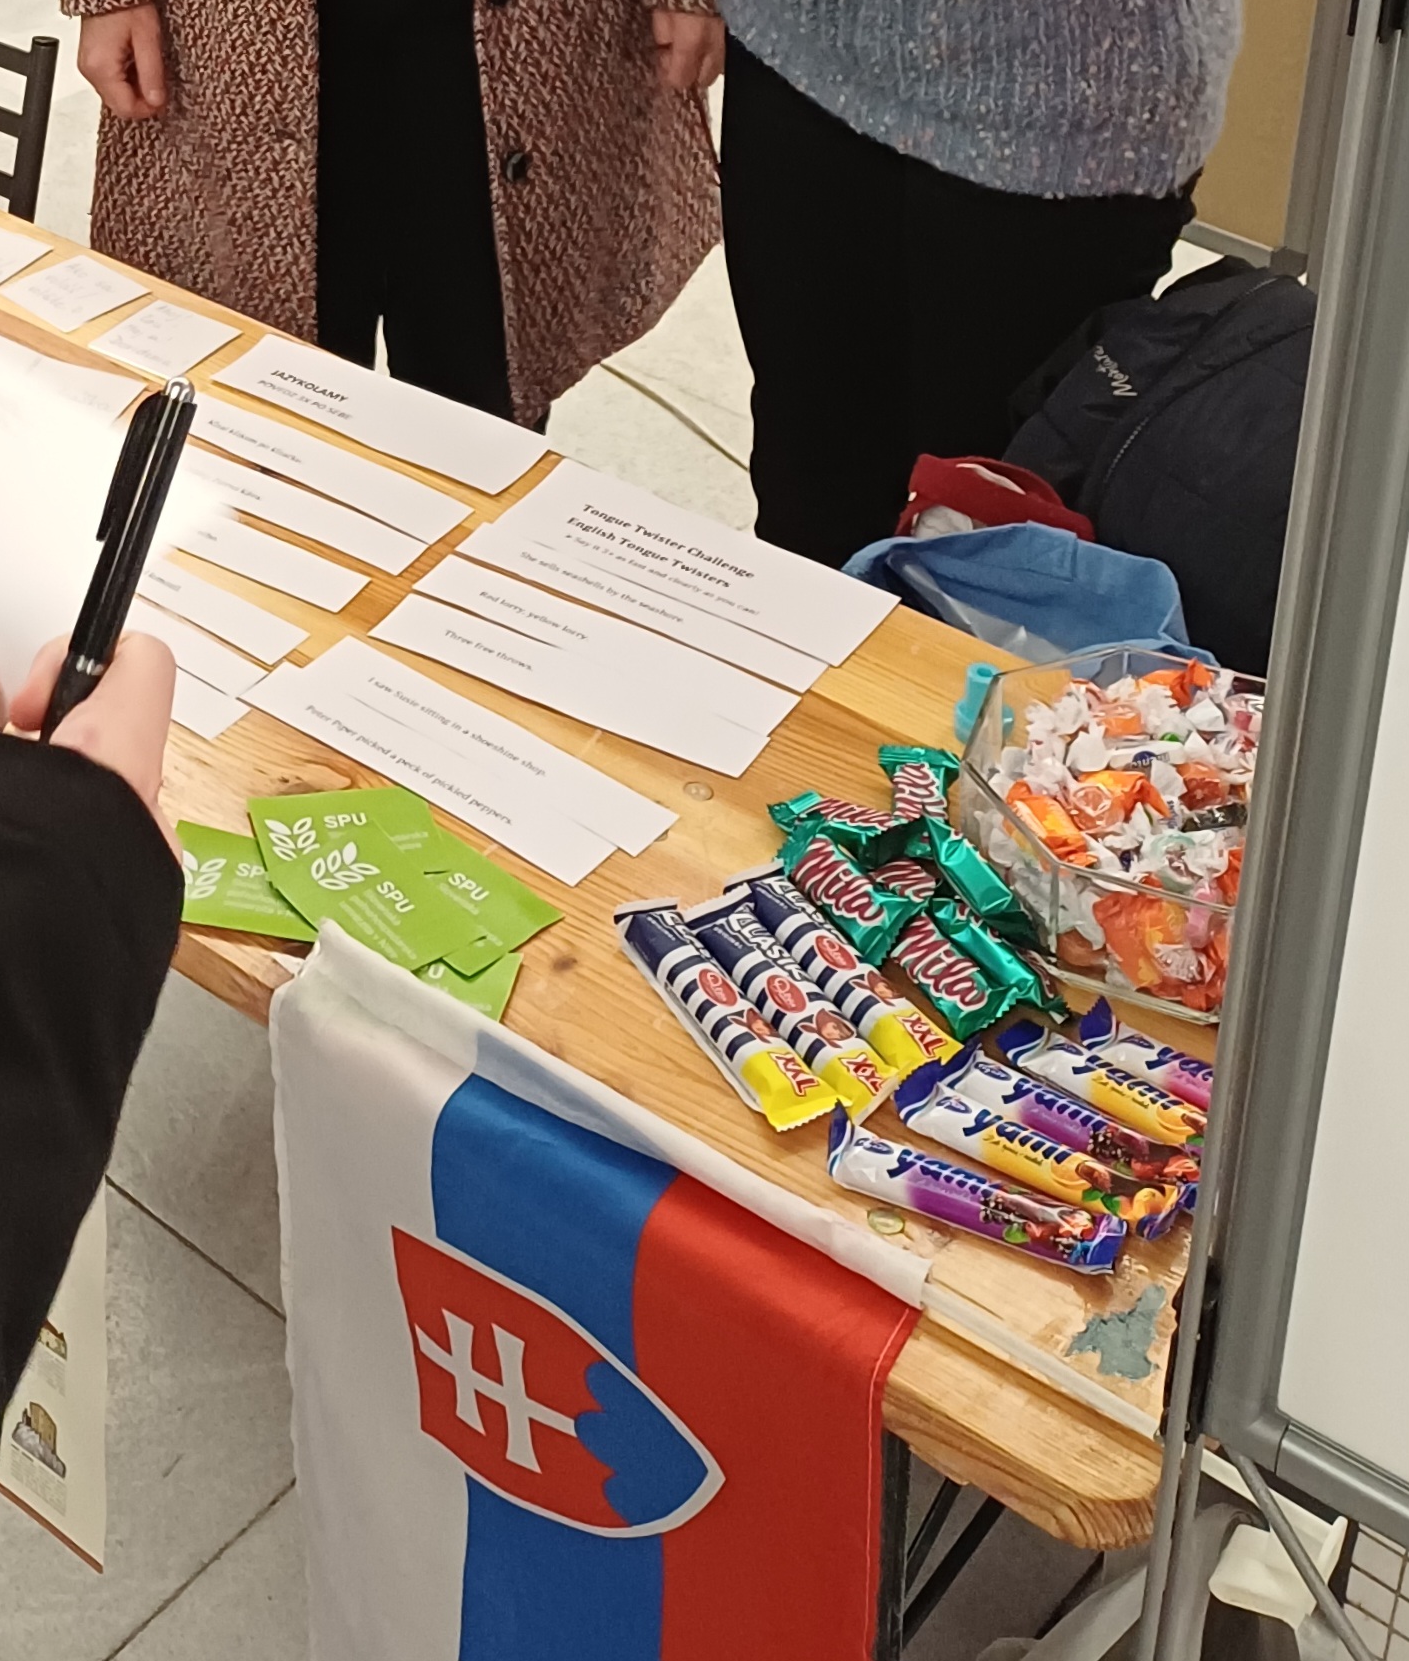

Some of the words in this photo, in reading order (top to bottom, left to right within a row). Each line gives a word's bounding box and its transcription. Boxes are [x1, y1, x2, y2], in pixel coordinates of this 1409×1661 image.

[258, 379, 297, 400] POVEDZ
[312, 400, 327, 410] PO
[327, 407, 352, 420] SEBE
[270, 369, 349, 403] JAZYKOLAMY
[567, 517, 617, 542] English
[618, 537, 669, 563] Tongue
[671, 558, 731, 588] Twisters
[583, 504, 632, 529] Tongue
[634, 524, 687, 551] Twister
[687, 547, 756, 580] Challenge
[520, 550, 538, 565] She
[539, 558, 560, 574] sells
[561, 566, 605, 592] seashells
[605, 583, 619, 598] by
[619, 590, 638, 605] the
[574, 536, 589, 548] Say
[628, 556, 648, 571] fast
[648, 565, 669, 579] and
[668, 574, 702, 594] clearly
[715, 595, 736, 608] you
[478, 590, 500, 604] Red
[527, 610, 563, 630] yellow
[444, 628, 474, 647] Three
[473, 640, 495, 656] free
[374, 680, 393, 694] saw
[393, 690, 420, 708] Susie
[420, 704, 450, 727] sitting
[450, 720, 463, 732] in
[470, 730, 520, 763] shoeshine
[520, 758, 547, 778] shop.
[305, 704, 332, 723] Peter
[331, 718, 358, 738] Piper
[356, 733, 391, 756] picked
[395, 755, 422, 774] peck
[421, 769, 434, 781] of
[431, 775, 472, 802] pickled
[468, 796, 514, 826] peppers.
[324, 812, 367, 829] SPU
[235, 862, 266, 878] SP
[448, 871, 490, 902] SPU
[791, 833, 886, 927] Mila
[376, 880, 416, 914] SPU
[727, 902, 811, 983] KLASIK
[890, 912, 990, 1012] Mila
[894, 1011, 948, 1058] XXL
[768, 1052, 820, 1097] XXL
[962, 1108, 1077, 1165] yami
